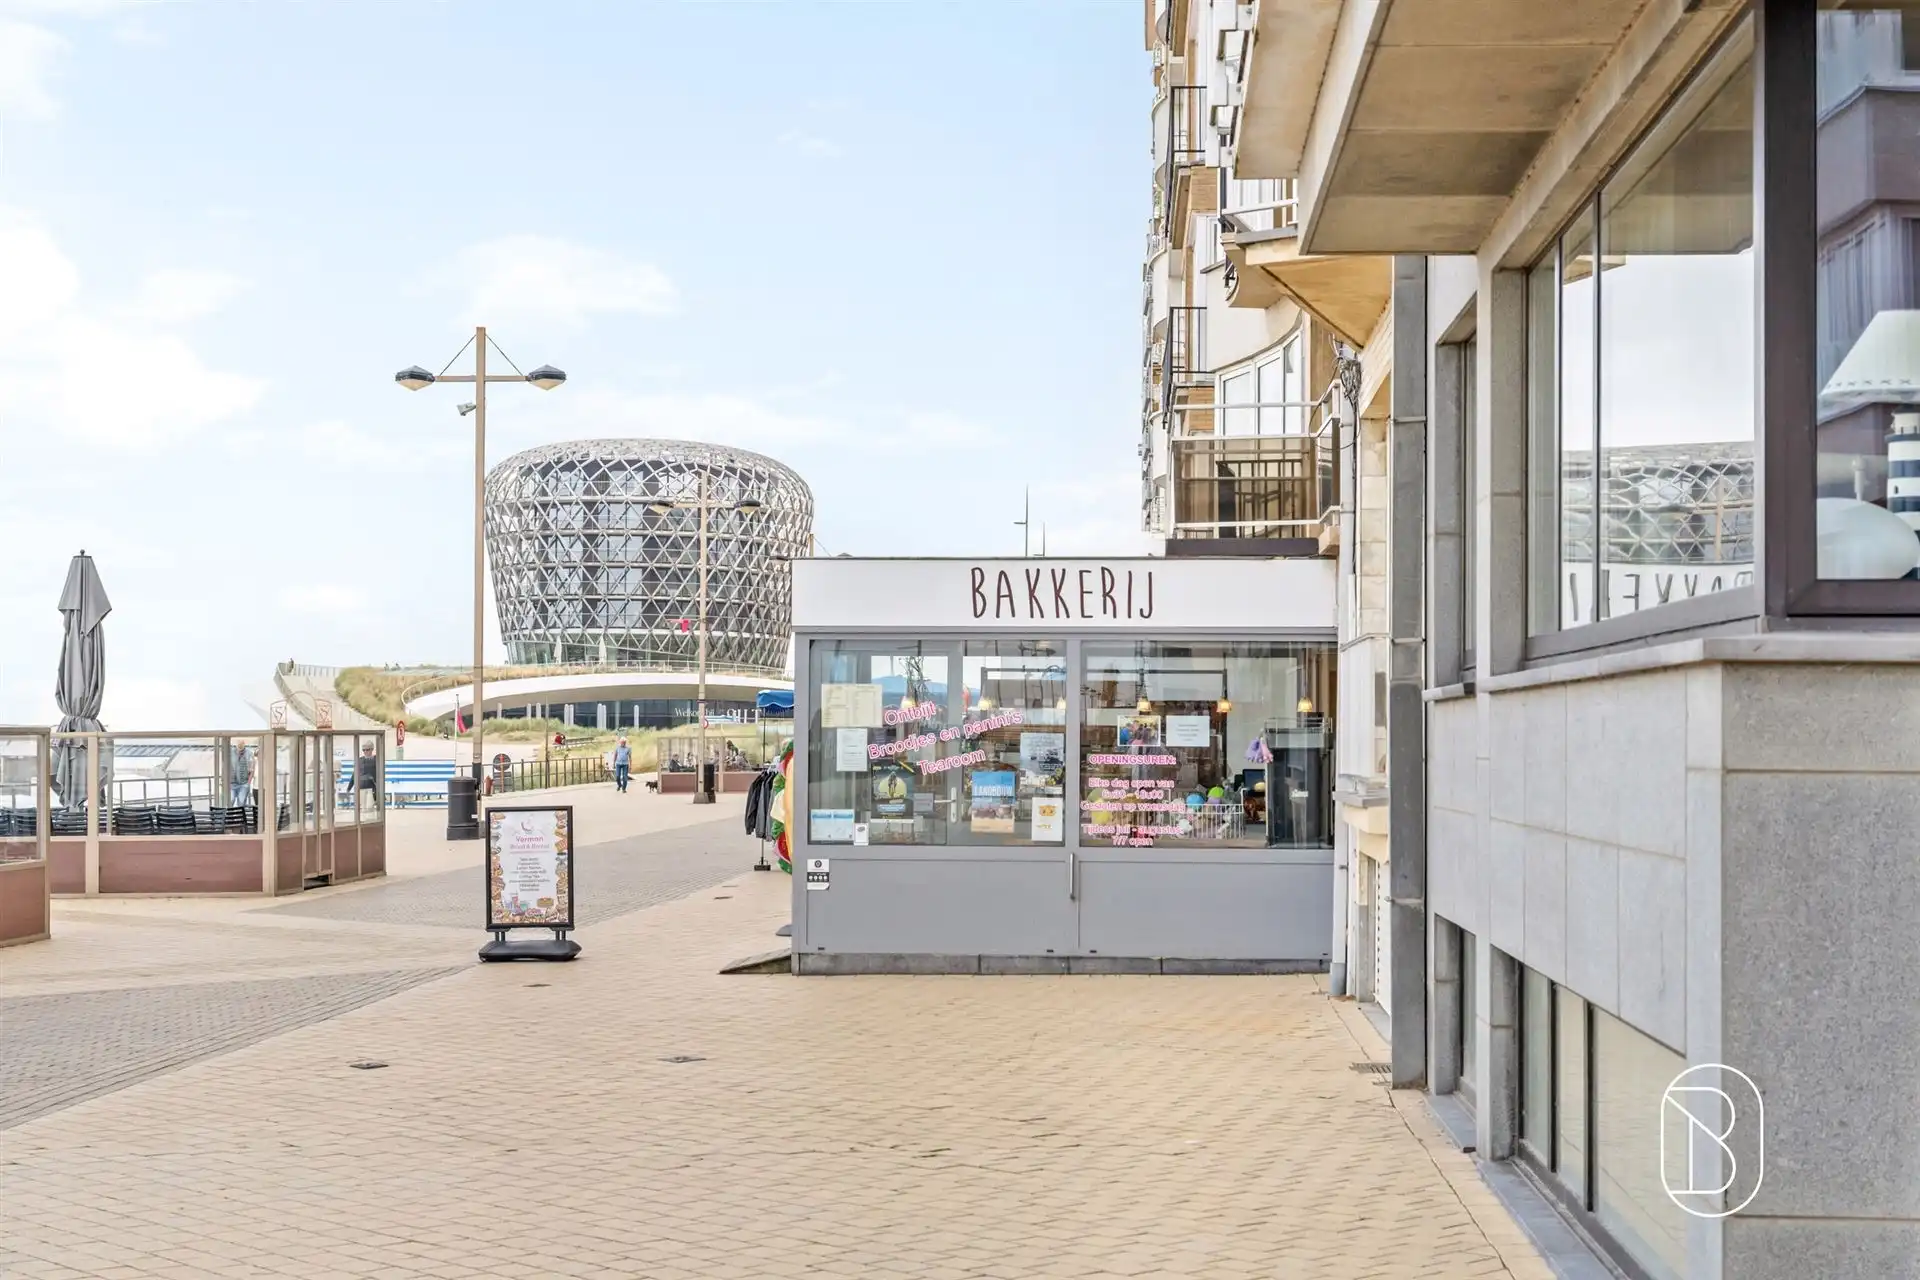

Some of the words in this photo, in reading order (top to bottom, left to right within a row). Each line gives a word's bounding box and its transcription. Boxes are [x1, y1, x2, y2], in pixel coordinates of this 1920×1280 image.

[970, 566, 1153, 619] BAKKERIJ
[884, 700, 936, 726] Ontbijt
[867, 731, 937, 760] Broodjes
[939, 725, 961, 742] en
[963, 710, 1024, 739] panini's
[919, 749, 986, 776] Tearoom
[1088, 754, 1177, 765] OPENINGSUREN:
[1111, 778, 1130, 790] dag
[1131, 779, 1155, 790] open
[1157, 780, 1175, 789] van
[1123, 803, 1137, 813] op
[1128, 837, 1154, 848] open
